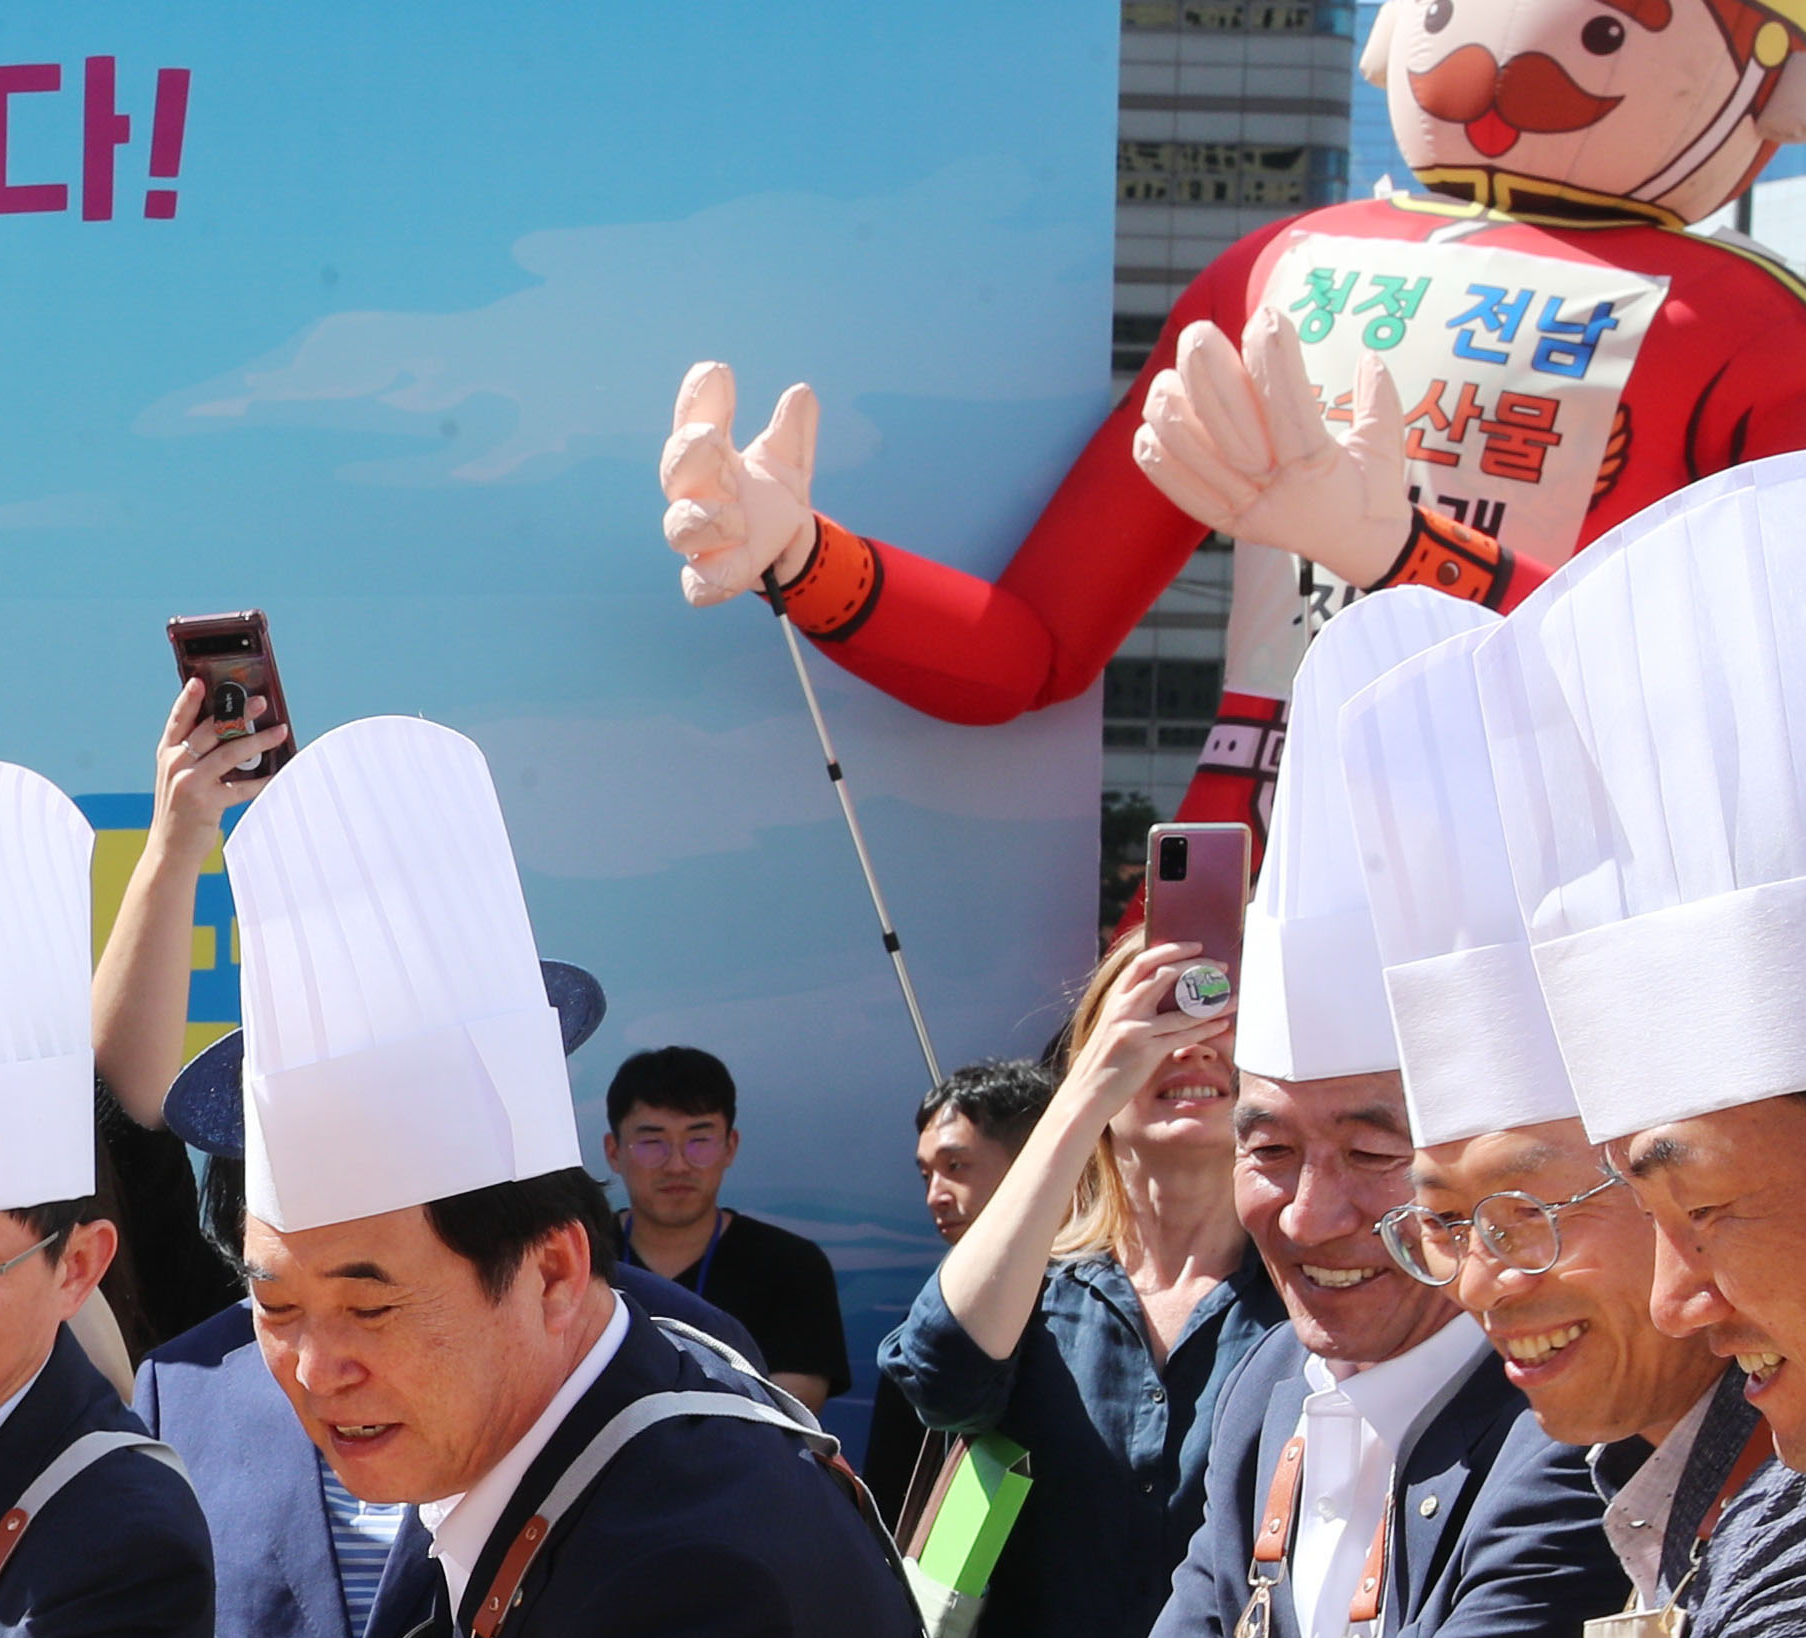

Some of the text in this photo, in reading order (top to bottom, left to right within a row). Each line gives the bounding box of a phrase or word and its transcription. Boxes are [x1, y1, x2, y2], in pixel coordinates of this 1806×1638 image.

[1290, 267, 1619, 379] 청정 전남
[1310, 379, 1562, 484] 산물
